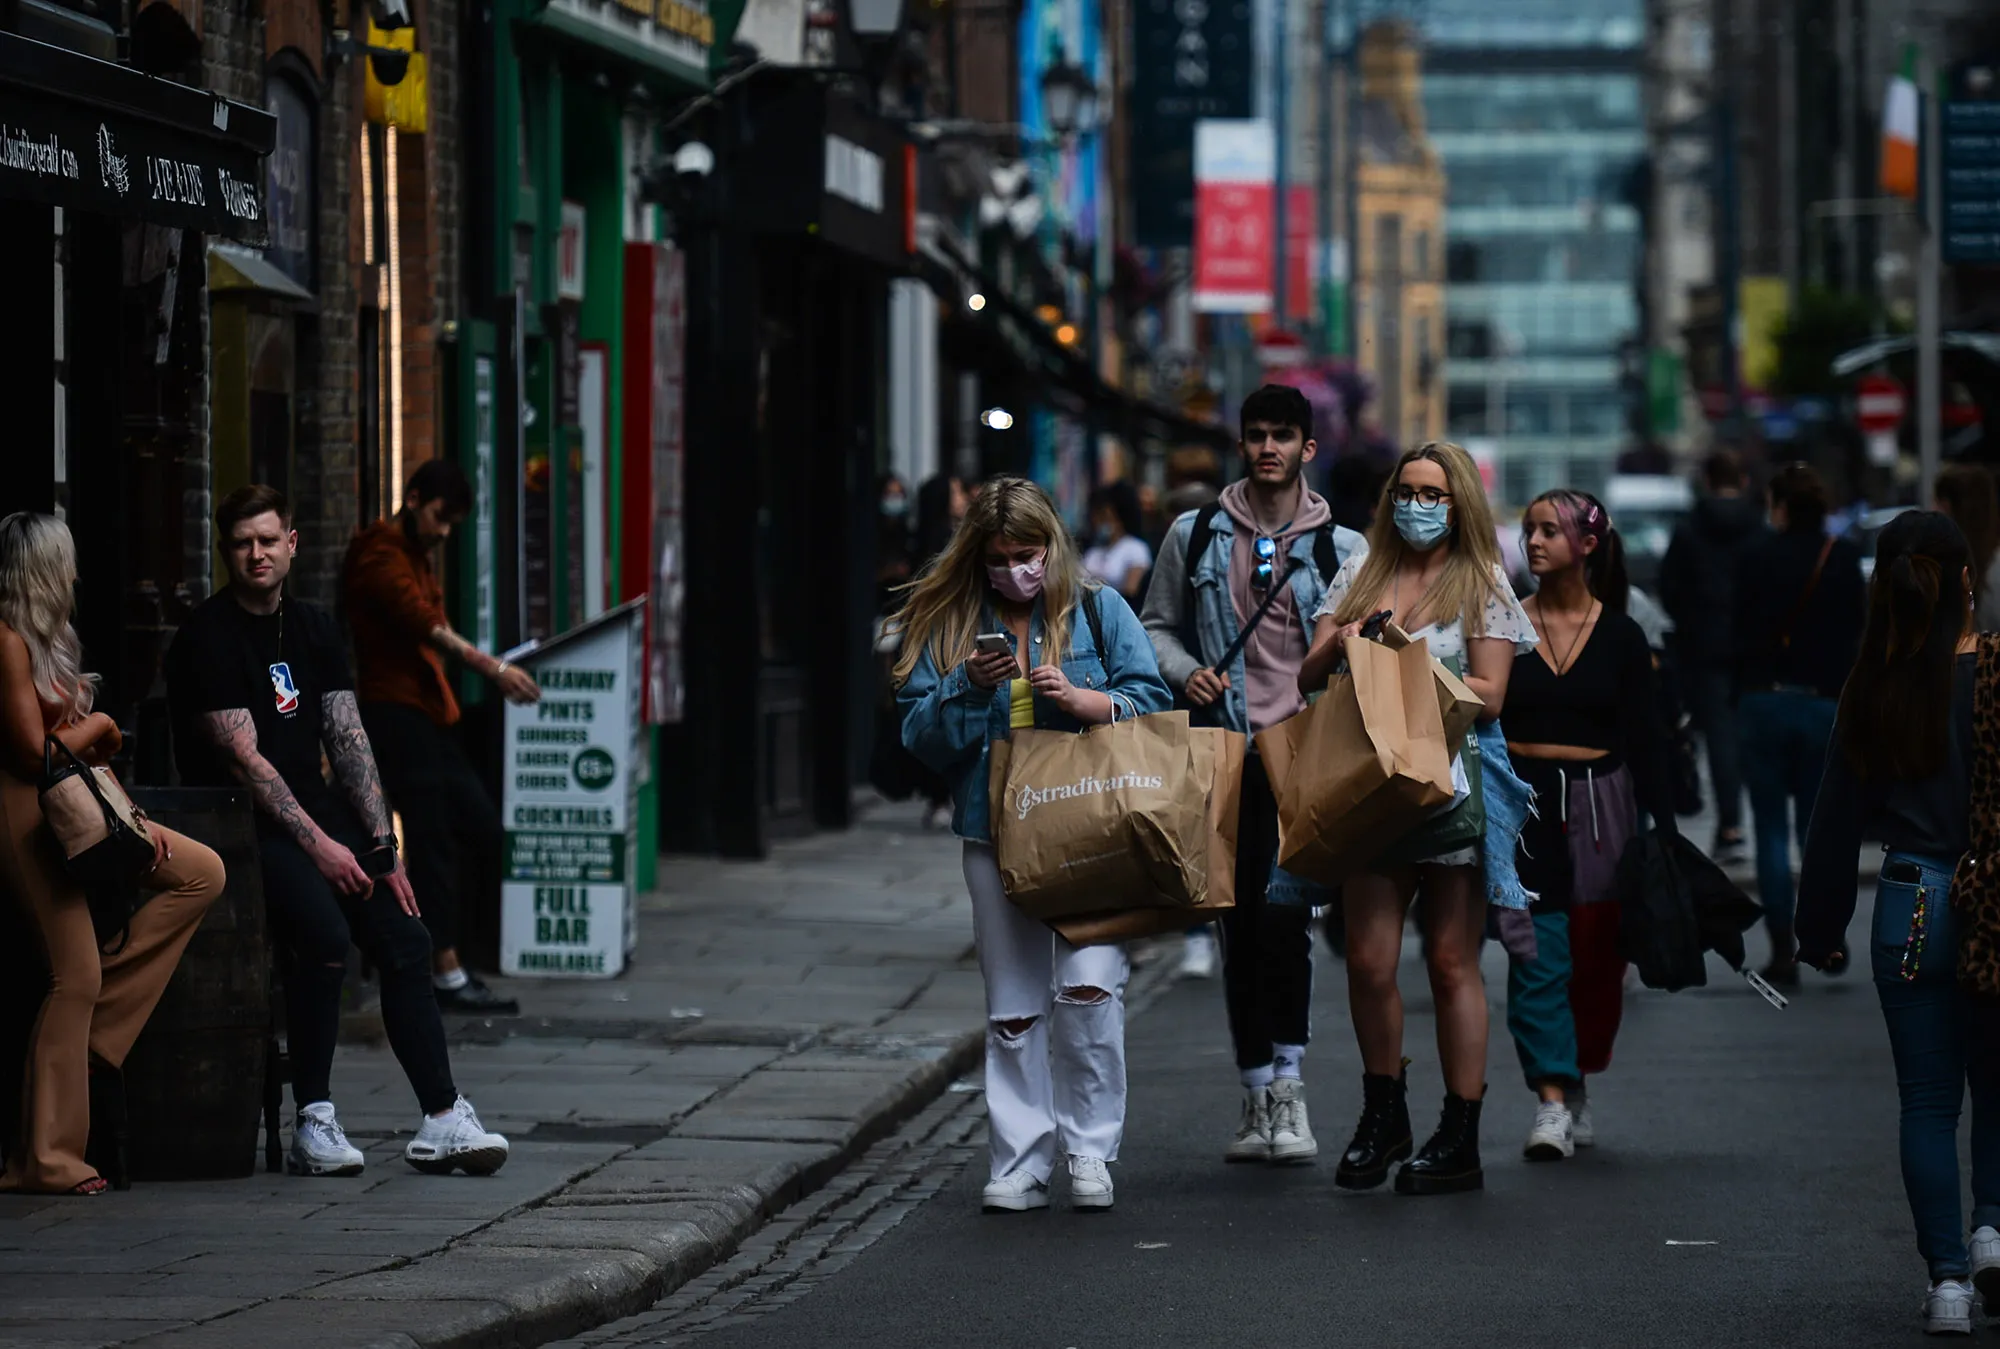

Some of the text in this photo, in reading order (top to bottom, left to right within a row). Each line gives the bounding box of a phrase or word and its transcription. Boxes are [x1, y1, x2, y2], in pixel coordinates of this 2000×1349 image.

[531, 670, 615, 691] KEAWAY
[539, 701, 593, 721] PINTS
[517, 728, 588, 744] GUINNESS
[1032, 770, 1162, 805] stradivarius
[515, 807, 613, 826] COCKTAILS
[535, 887, 589, 914] FULL
[536, 918, 589, 943] BAR
[519, 953, 604, 973] AVAILABLE
